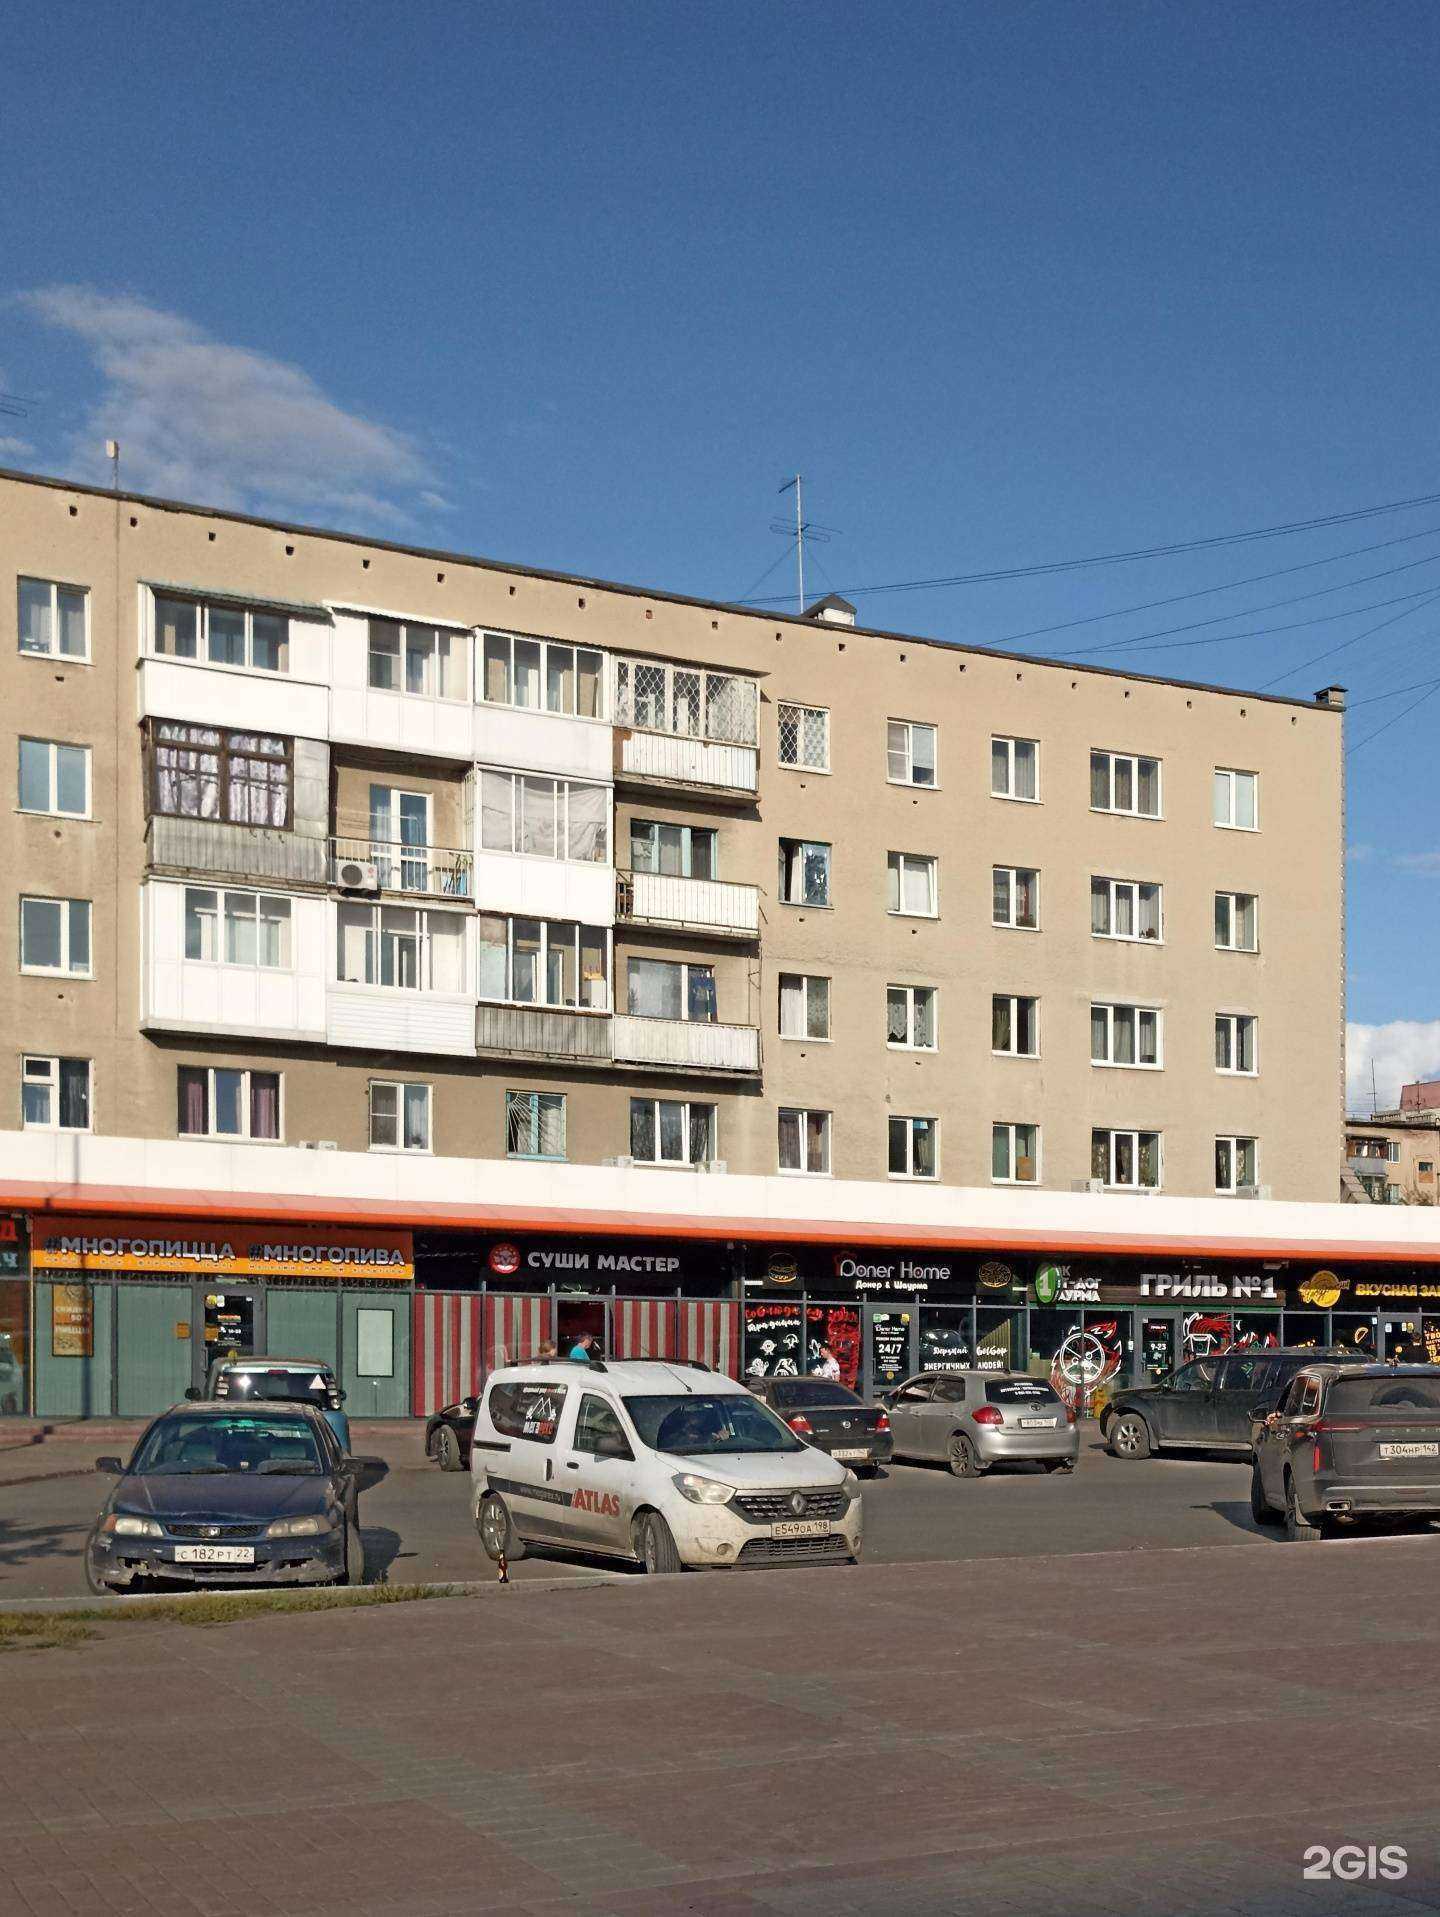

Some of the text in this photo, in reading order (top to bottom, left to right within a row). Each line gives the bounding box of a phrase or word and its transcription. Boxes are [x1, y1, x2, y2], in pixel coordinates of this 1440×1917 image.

[45, 1236, 406, 1266] #МНОГОПИЦЦА #МНОГОПИВА
[527, 1252, 680, 1272] СУШИ МАСТЕР
[840, 1259, 951, 1280] Doner Home
[856, 1280, 882, 1290] Донер
[894, 1281, 928, 1291] Шаурма
[1140, 1274, 1228, 1297] ГРИЛЬ
[1233, 1276, 1277, 1298] №1
[1355, 1284, 1417, 1296] ВКУСНАЯ
[878, 1344, 902, 1354] 24/7
[572, 1489, 620, 1517] ATLAS
